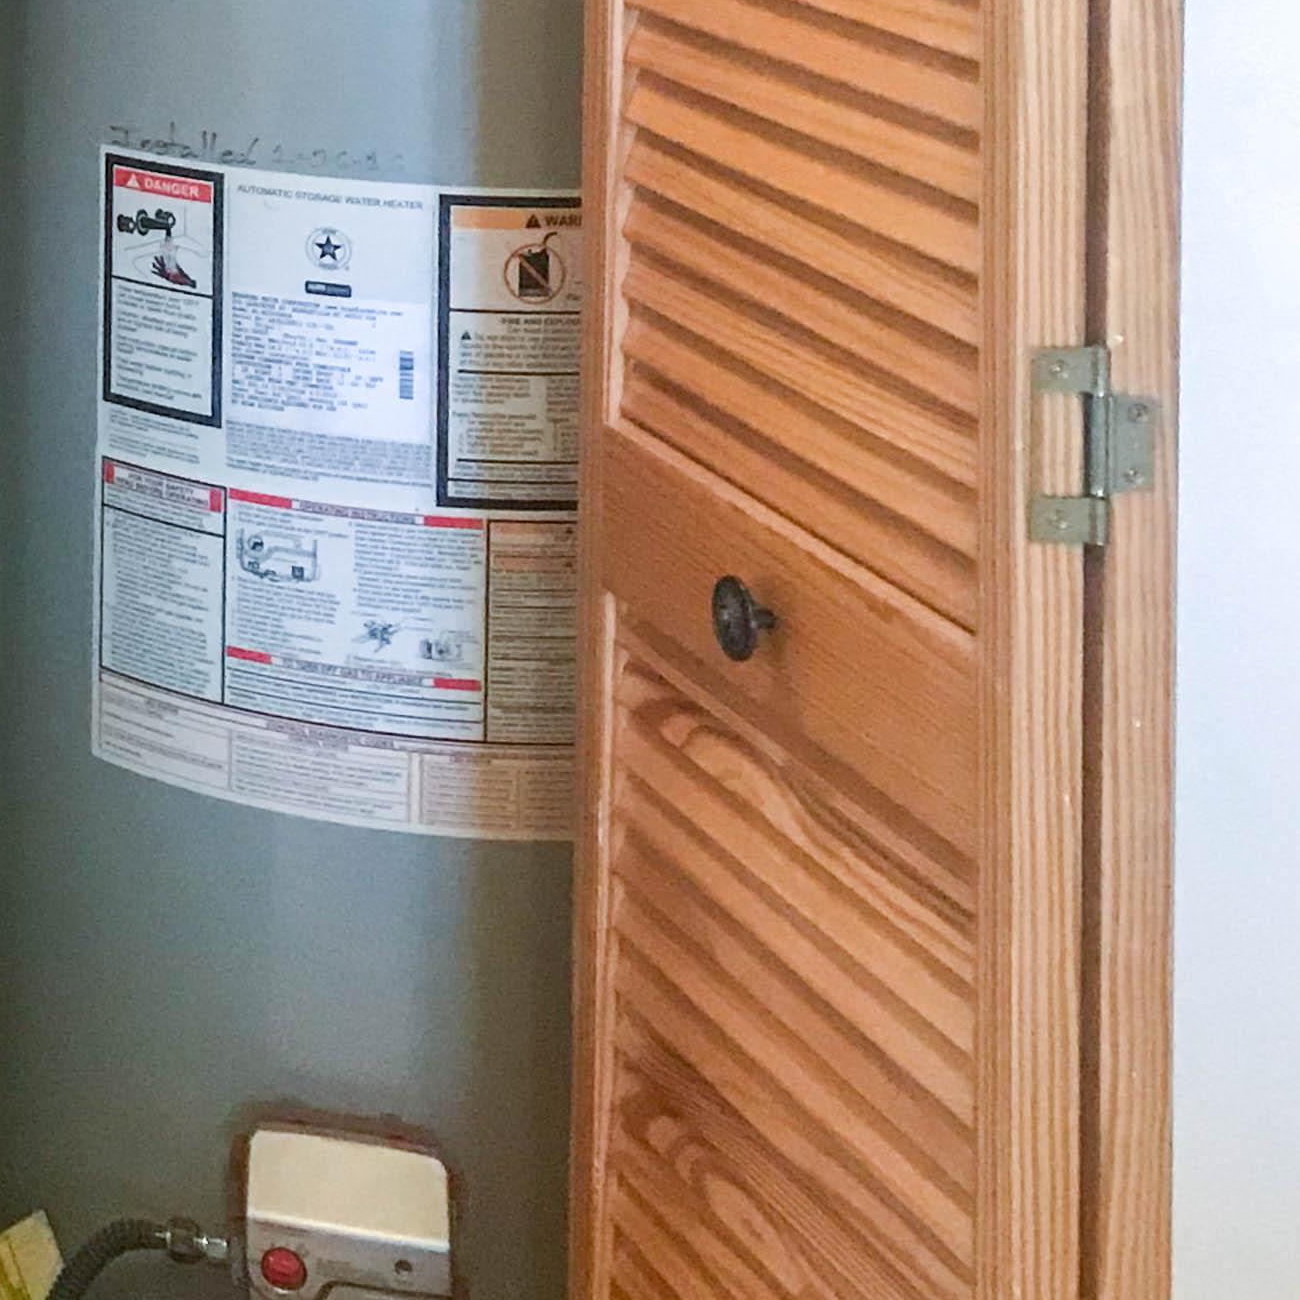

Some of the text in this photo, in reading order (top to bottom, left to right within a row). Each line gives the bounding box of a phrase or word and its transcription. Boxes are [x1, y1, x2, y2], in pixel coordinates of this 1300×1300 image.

[143, 178, 201, 198] DANGER
[236, 184, 293, 198] AUTOMATIC
[344, 196, 382, 208] WATER
[382, 199, 425, 211] HEATER
